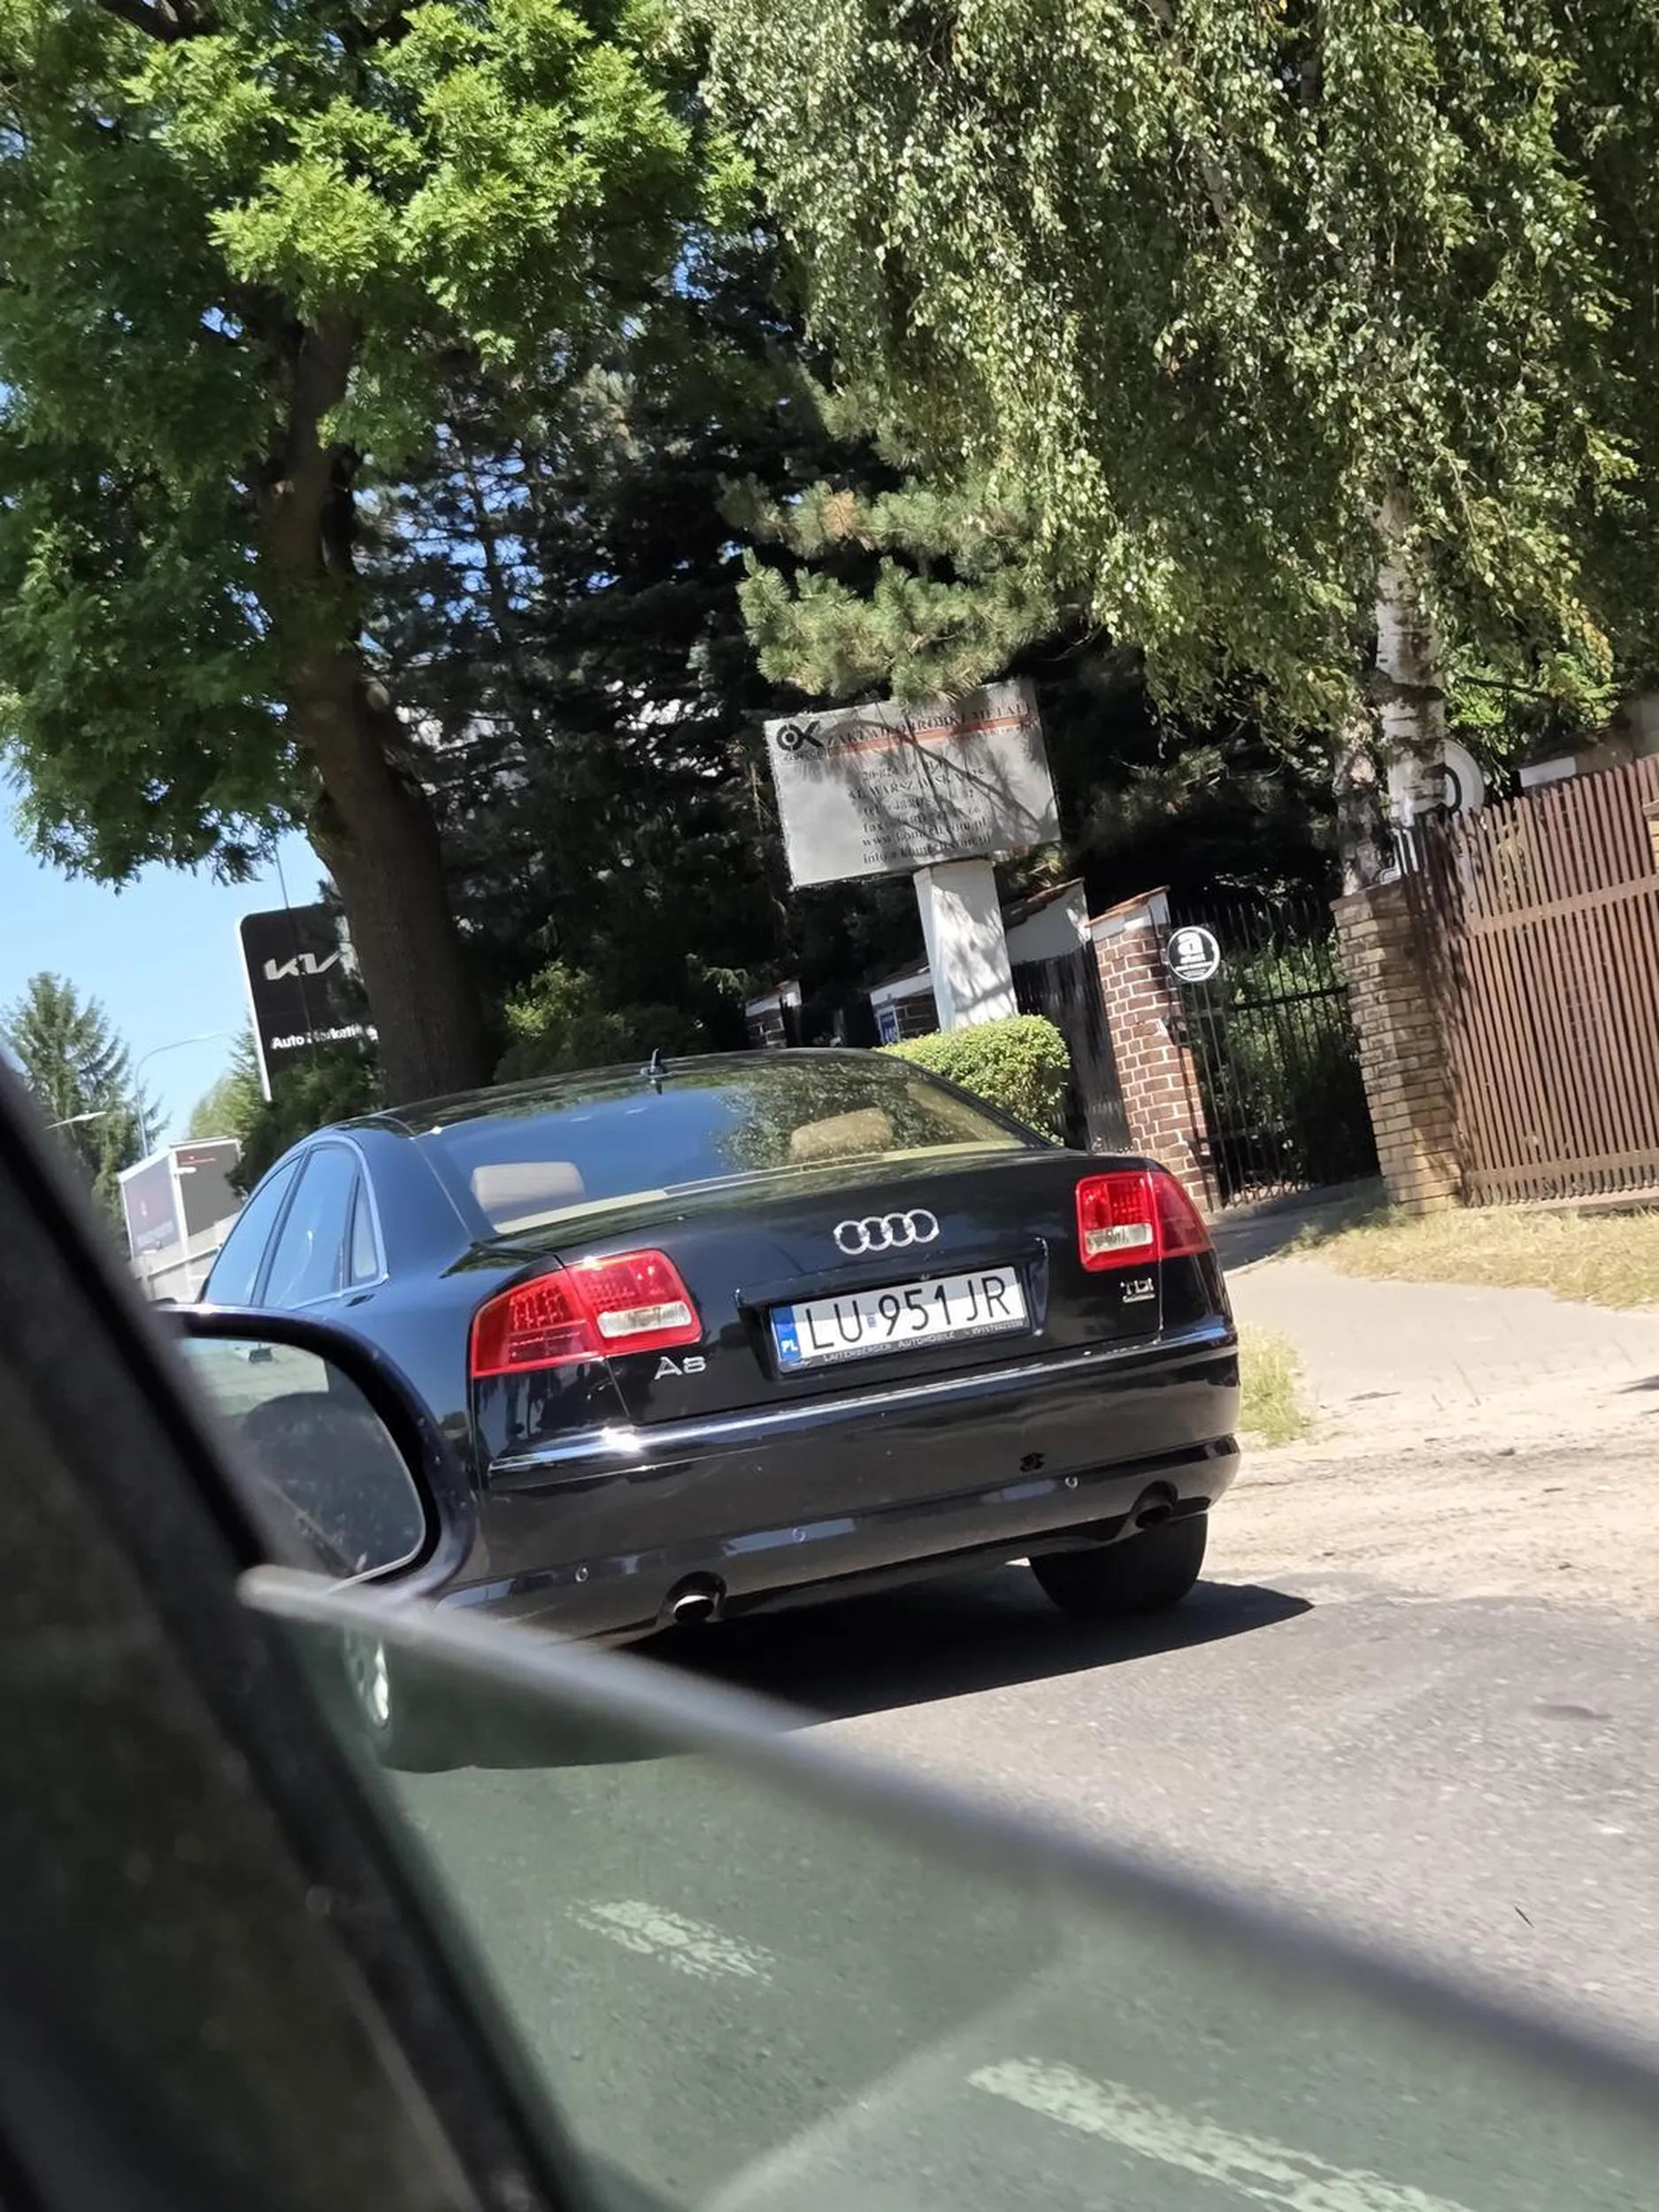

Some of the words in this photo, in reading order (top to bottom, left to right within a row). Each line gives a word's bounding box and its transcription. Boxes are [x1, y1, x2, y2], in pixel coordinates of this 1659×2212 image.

[271, 1033, 305, 1050] Auto
[806, 1300, 864, 1349] LU
[780, 1339, 798, 1353] PL
[654, 1356, 707, 1380] A8
